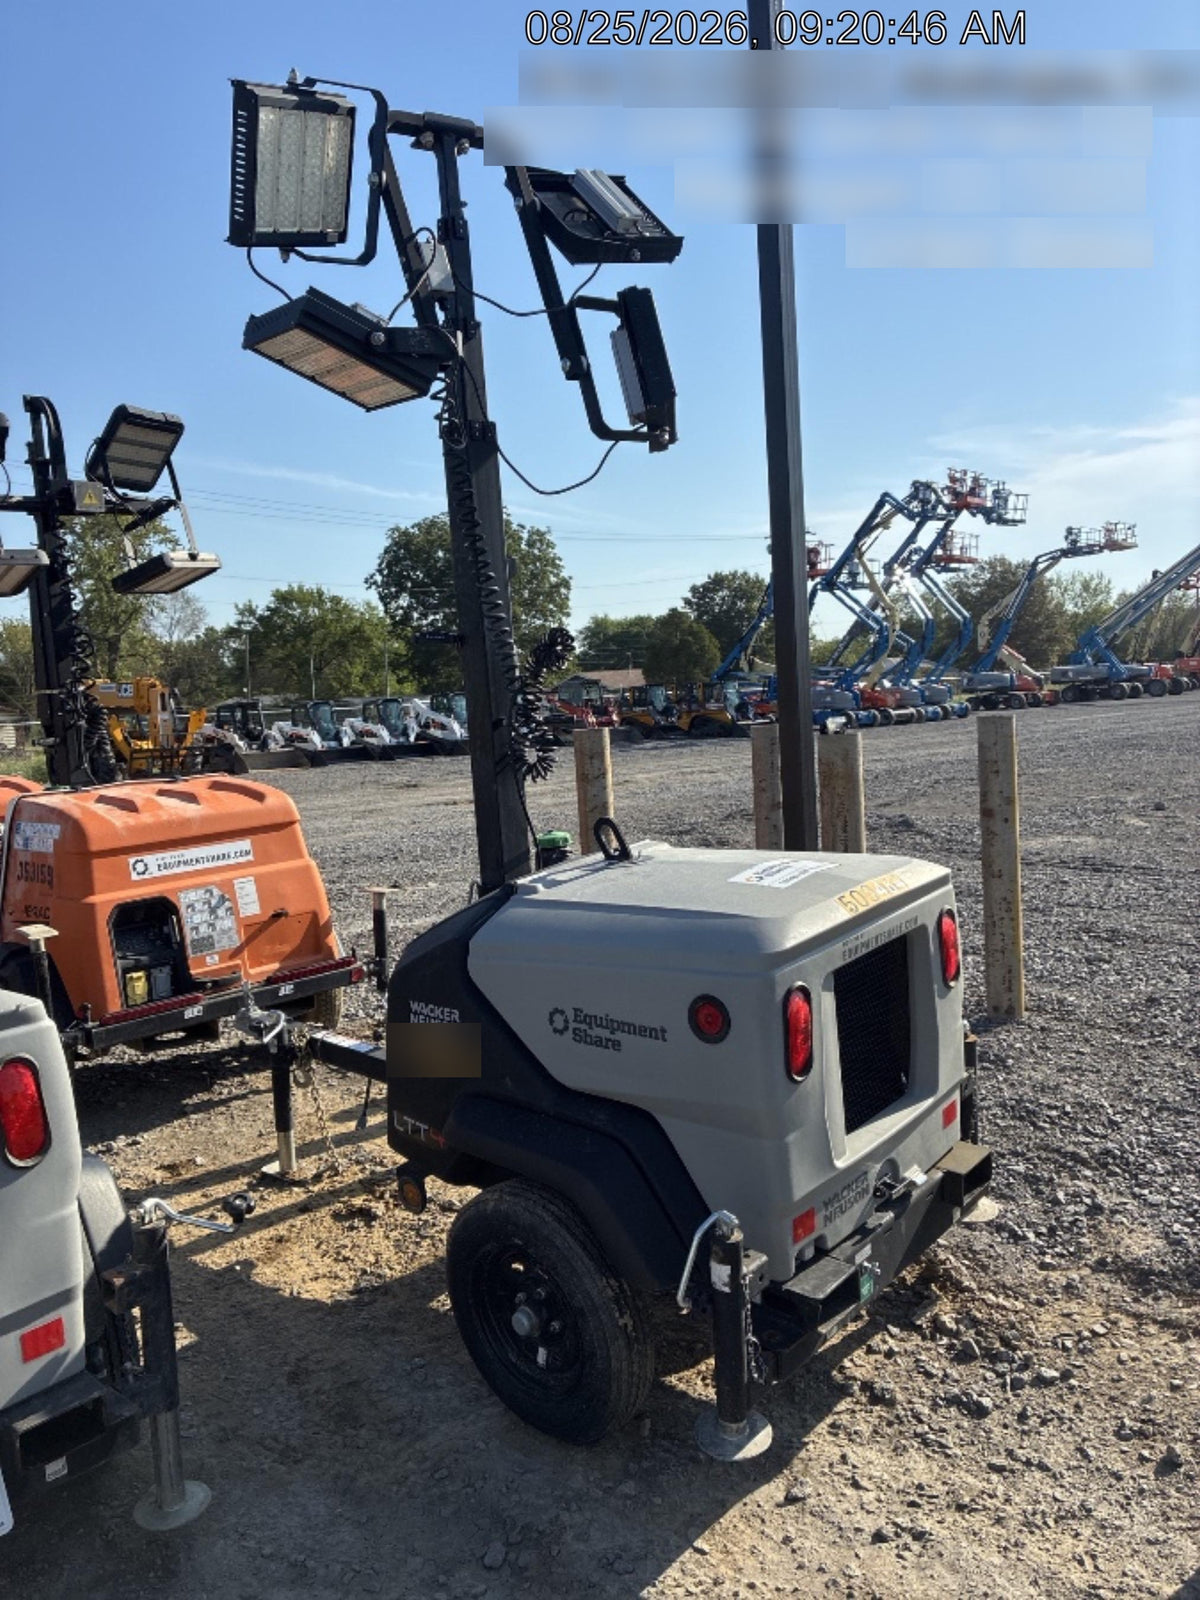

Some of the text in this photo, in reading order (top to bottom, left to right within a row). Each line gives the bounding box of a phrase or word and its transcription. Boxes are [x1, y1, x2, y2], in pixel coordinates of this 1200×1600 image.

[408, 1000, 460, 1022] WACKER
[572, 1007, 668, 1042] Equipment
[572, 1027, 622, 1052] Share
[823, 1171, 869, 1210] WACKER
